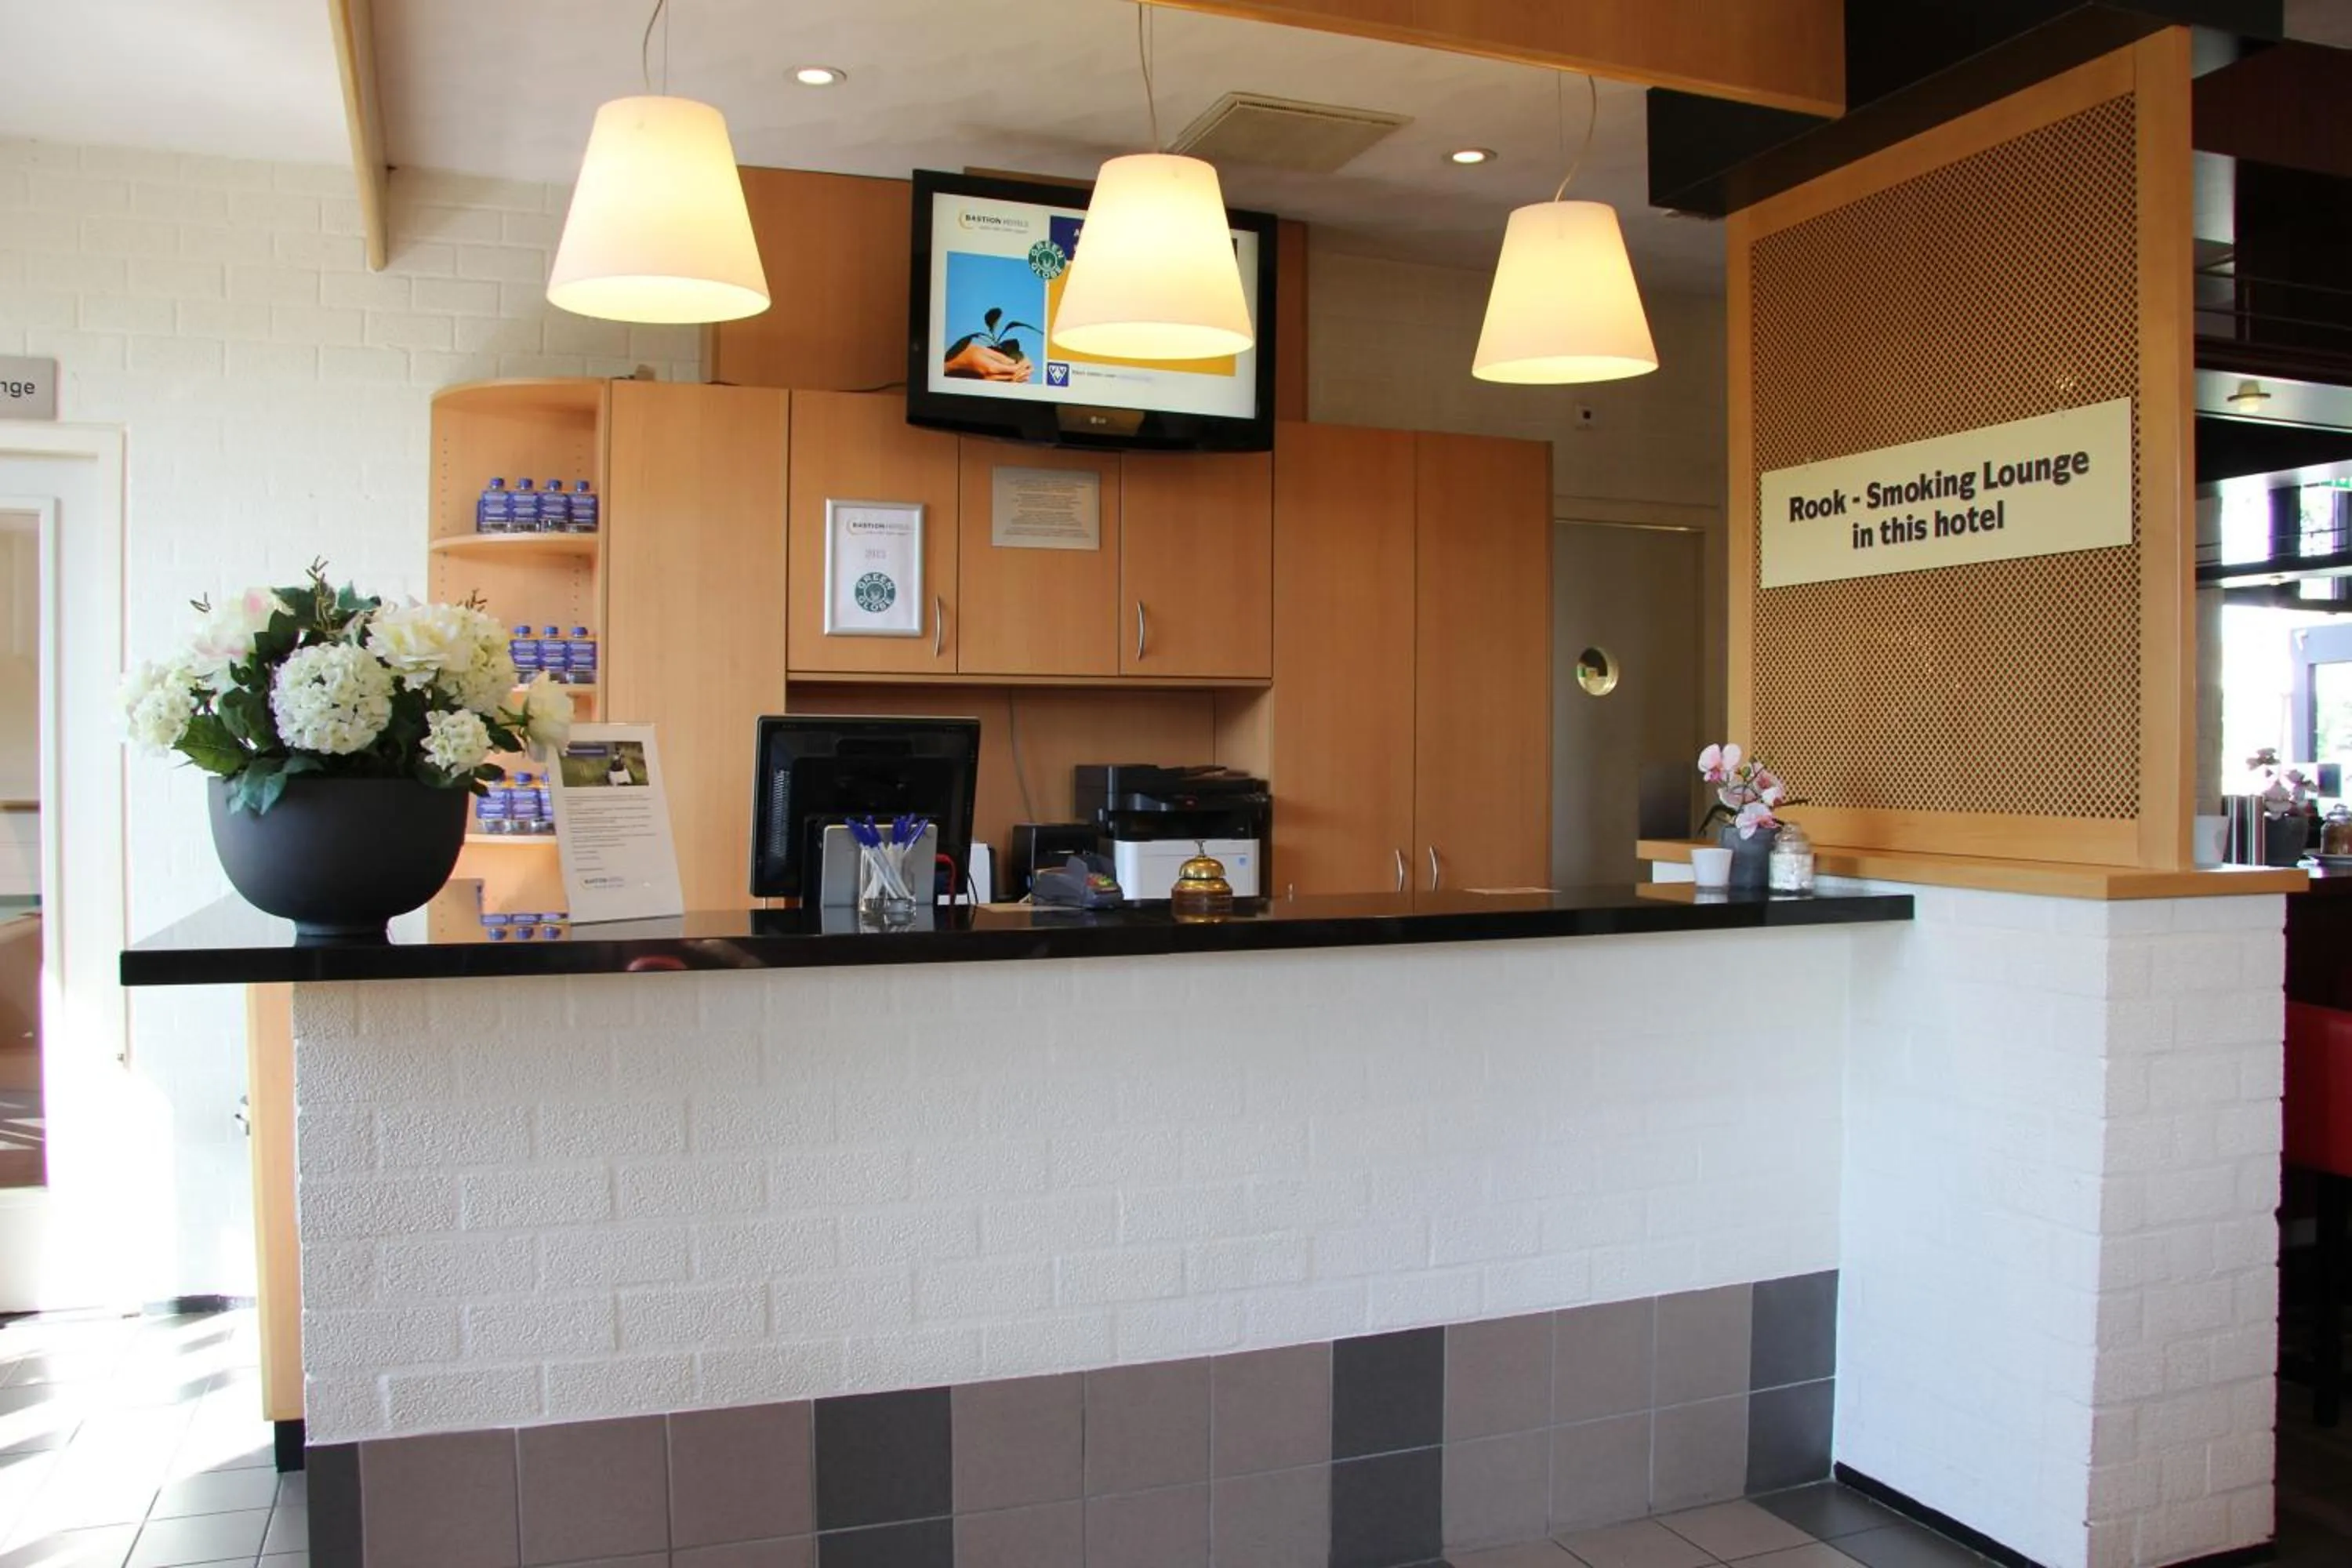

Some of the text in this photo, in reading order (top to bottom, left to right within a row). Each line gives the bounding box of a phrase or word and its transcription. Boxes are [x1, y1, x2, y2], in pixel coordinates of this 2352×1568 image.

[1789, 488, 1846, 522] Rook
[1867, 469, 1976, 509] Smoking
[1983, 451, 2089, 490] Lounge
[1853, 499, 2005, 549] in this hotel
